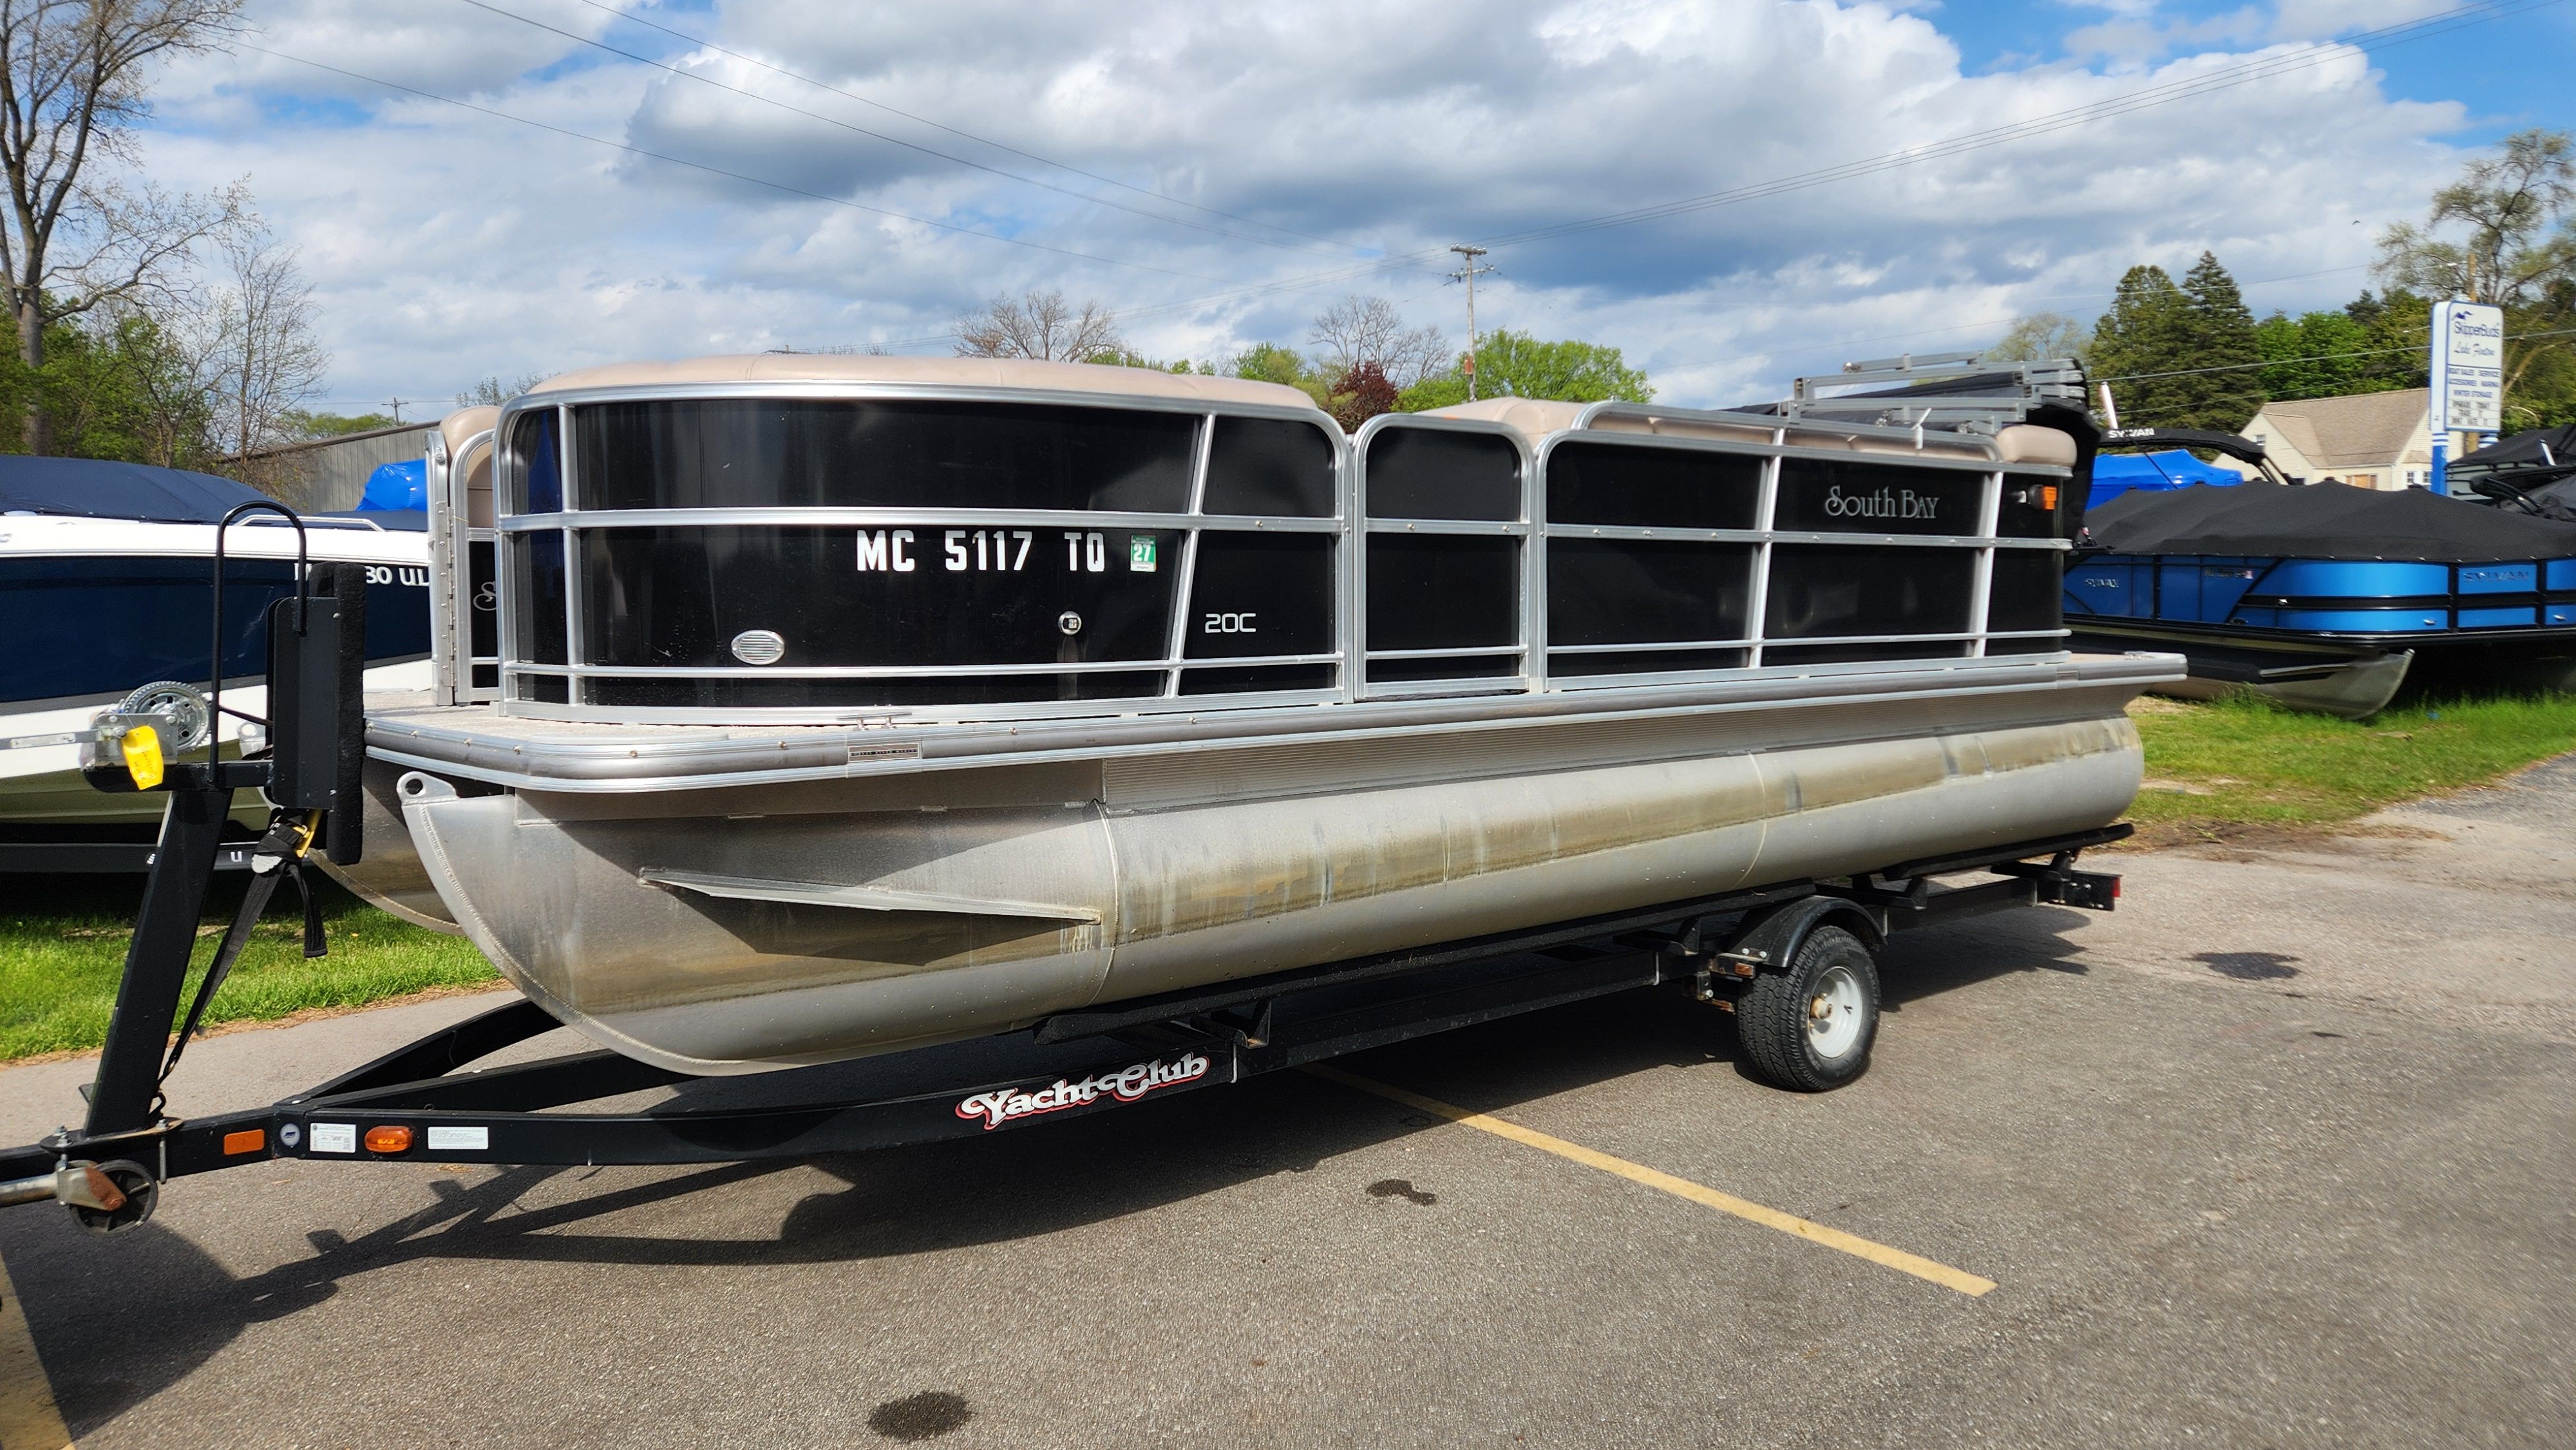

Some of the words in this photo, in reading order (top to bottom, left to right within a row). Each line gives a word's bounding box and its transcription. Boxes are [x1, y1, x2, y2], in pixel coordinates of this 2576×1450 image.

[1825, 485, 1897, 517] South
[857, 530, 915, 572] MC
[945, 530, 1032, 572] 5117
[1133, 543, 1151, 562] 27
[1205, 613, 1256, 633] 20C
[956, 1075, 1097, 1129] Yacht
[1096, 1052, 1210, 1101] Club
